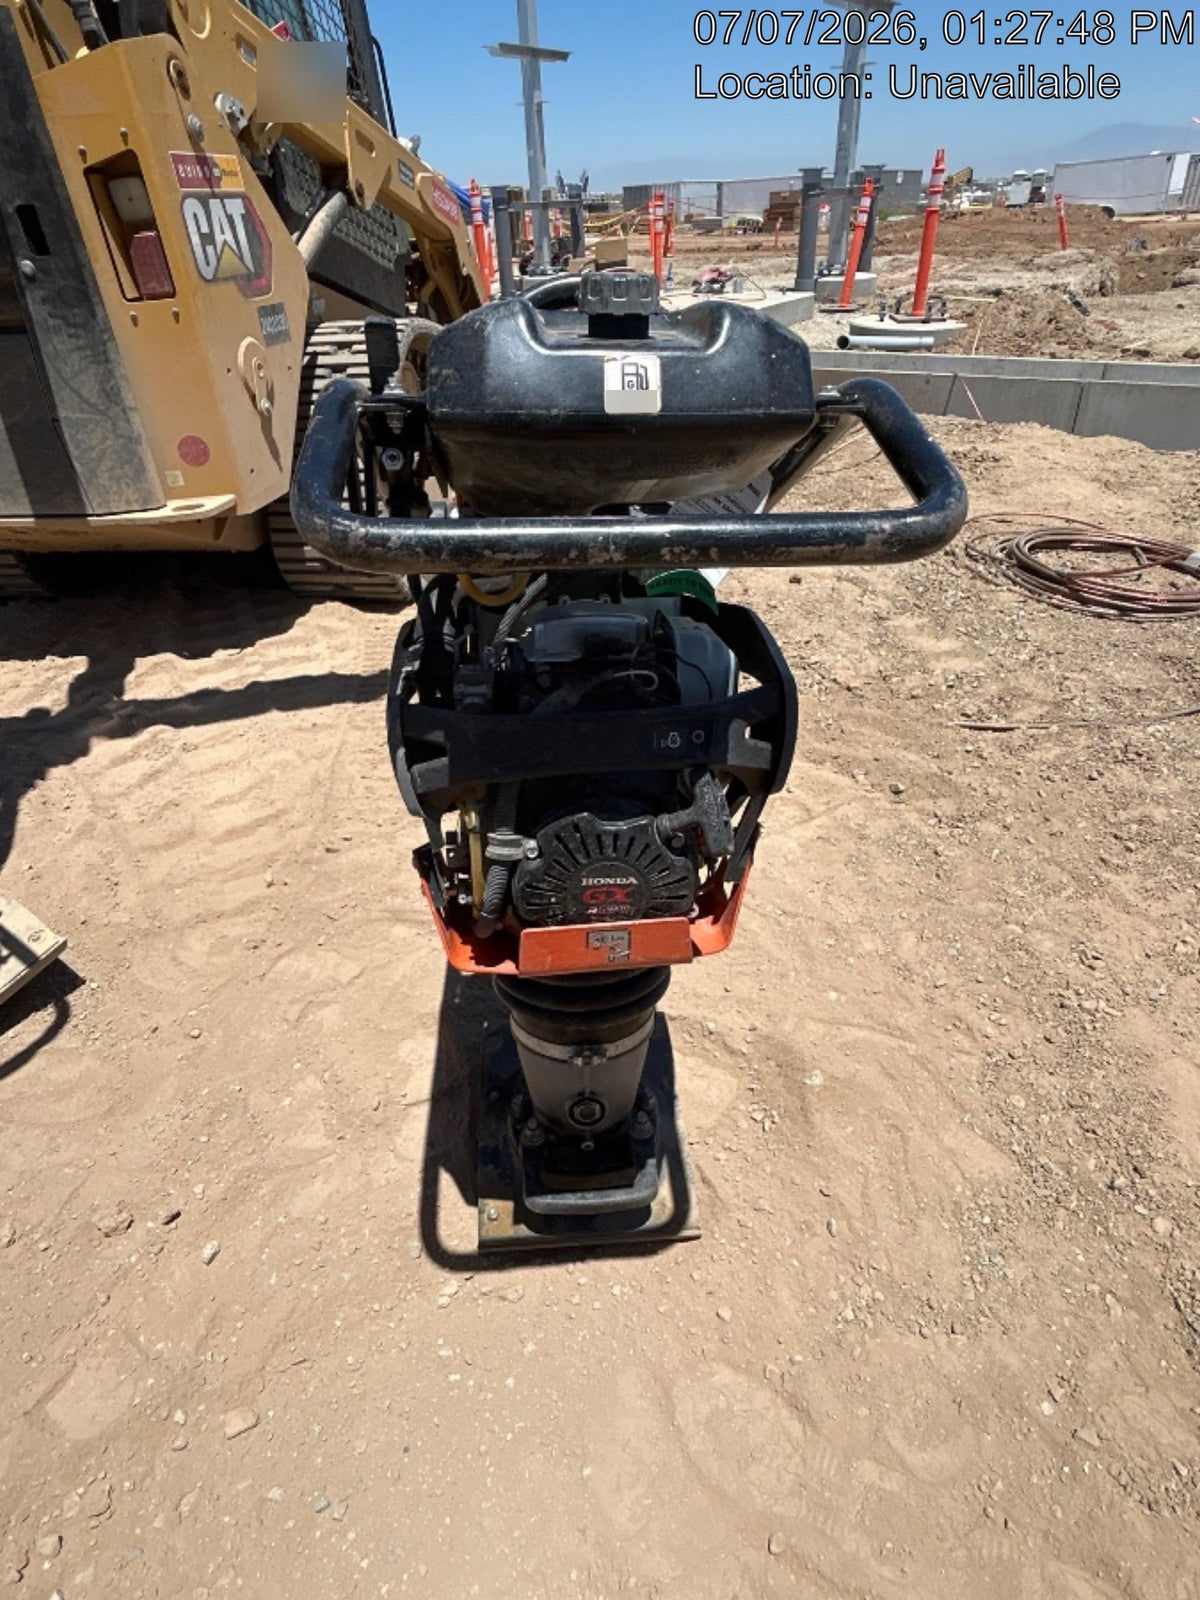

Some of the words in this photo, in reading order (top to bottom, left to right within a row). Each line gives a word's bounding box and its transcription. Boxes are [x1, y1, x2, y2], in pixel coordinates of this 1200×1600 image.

[182, 197, 255, 280] CAT
[581, 876, 639, 887] HONDA
[582, 887, 636, 905] GX
